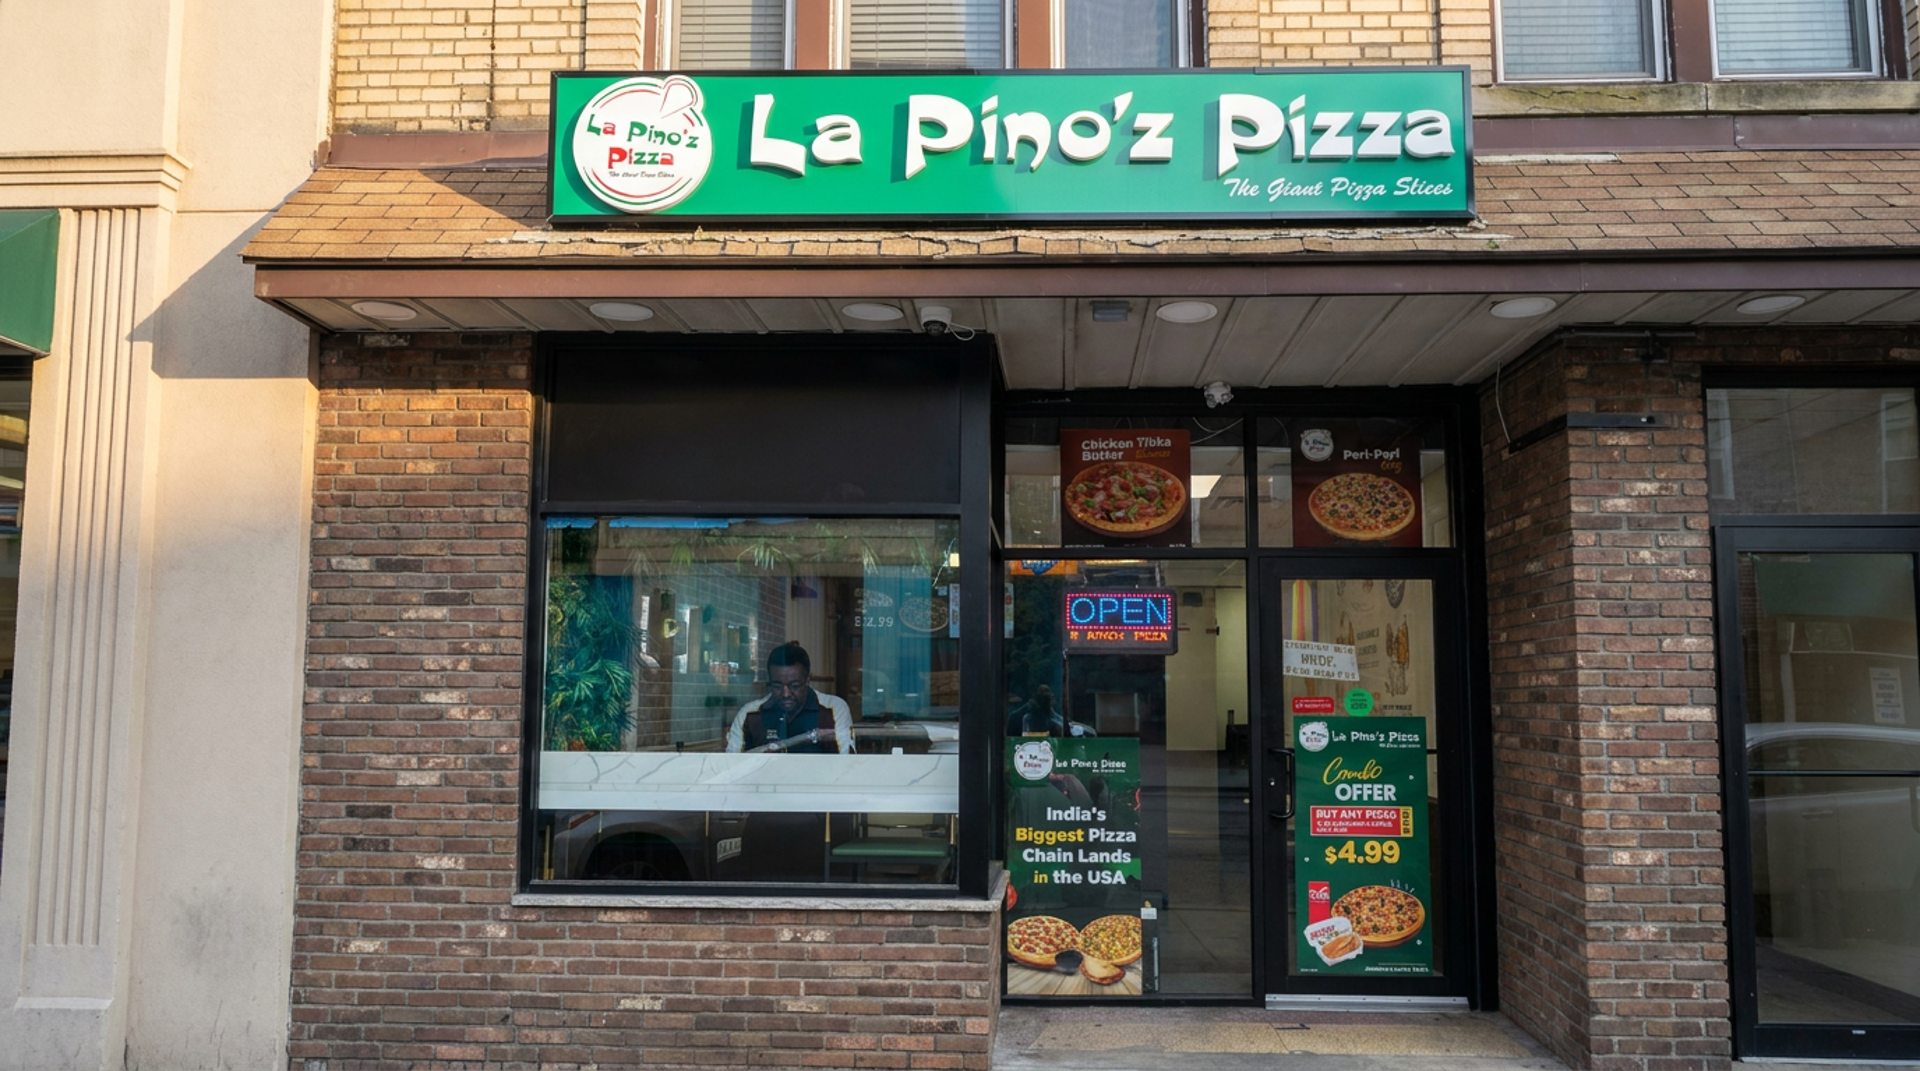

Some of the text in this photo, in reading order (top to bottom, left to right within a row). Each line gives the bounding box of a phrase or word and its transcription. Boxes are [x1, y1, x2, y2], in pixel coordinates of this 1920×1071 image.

[586, 113, 699, 148] La Pino'z
[750, 91, 1456, 180] La Pino'z Pizza
[608, 147, 674, 169] Pizza
[1224, 178, 1259, 197] The
[1330, 177, 1387, 201] Pizza
[1071, 598, 1167, 624] OPEN
[1335, 783, 1397, 801] OFFER
[1046, 806, 1107, 821] India's
[1015, 827, 1137, 845] Biggest Pizza
[1022, 848, 1132, 863] Chain Lands
[1325, 840, 1401, 865] $4.99
[1033, 869, 1127, 884] in the USA
